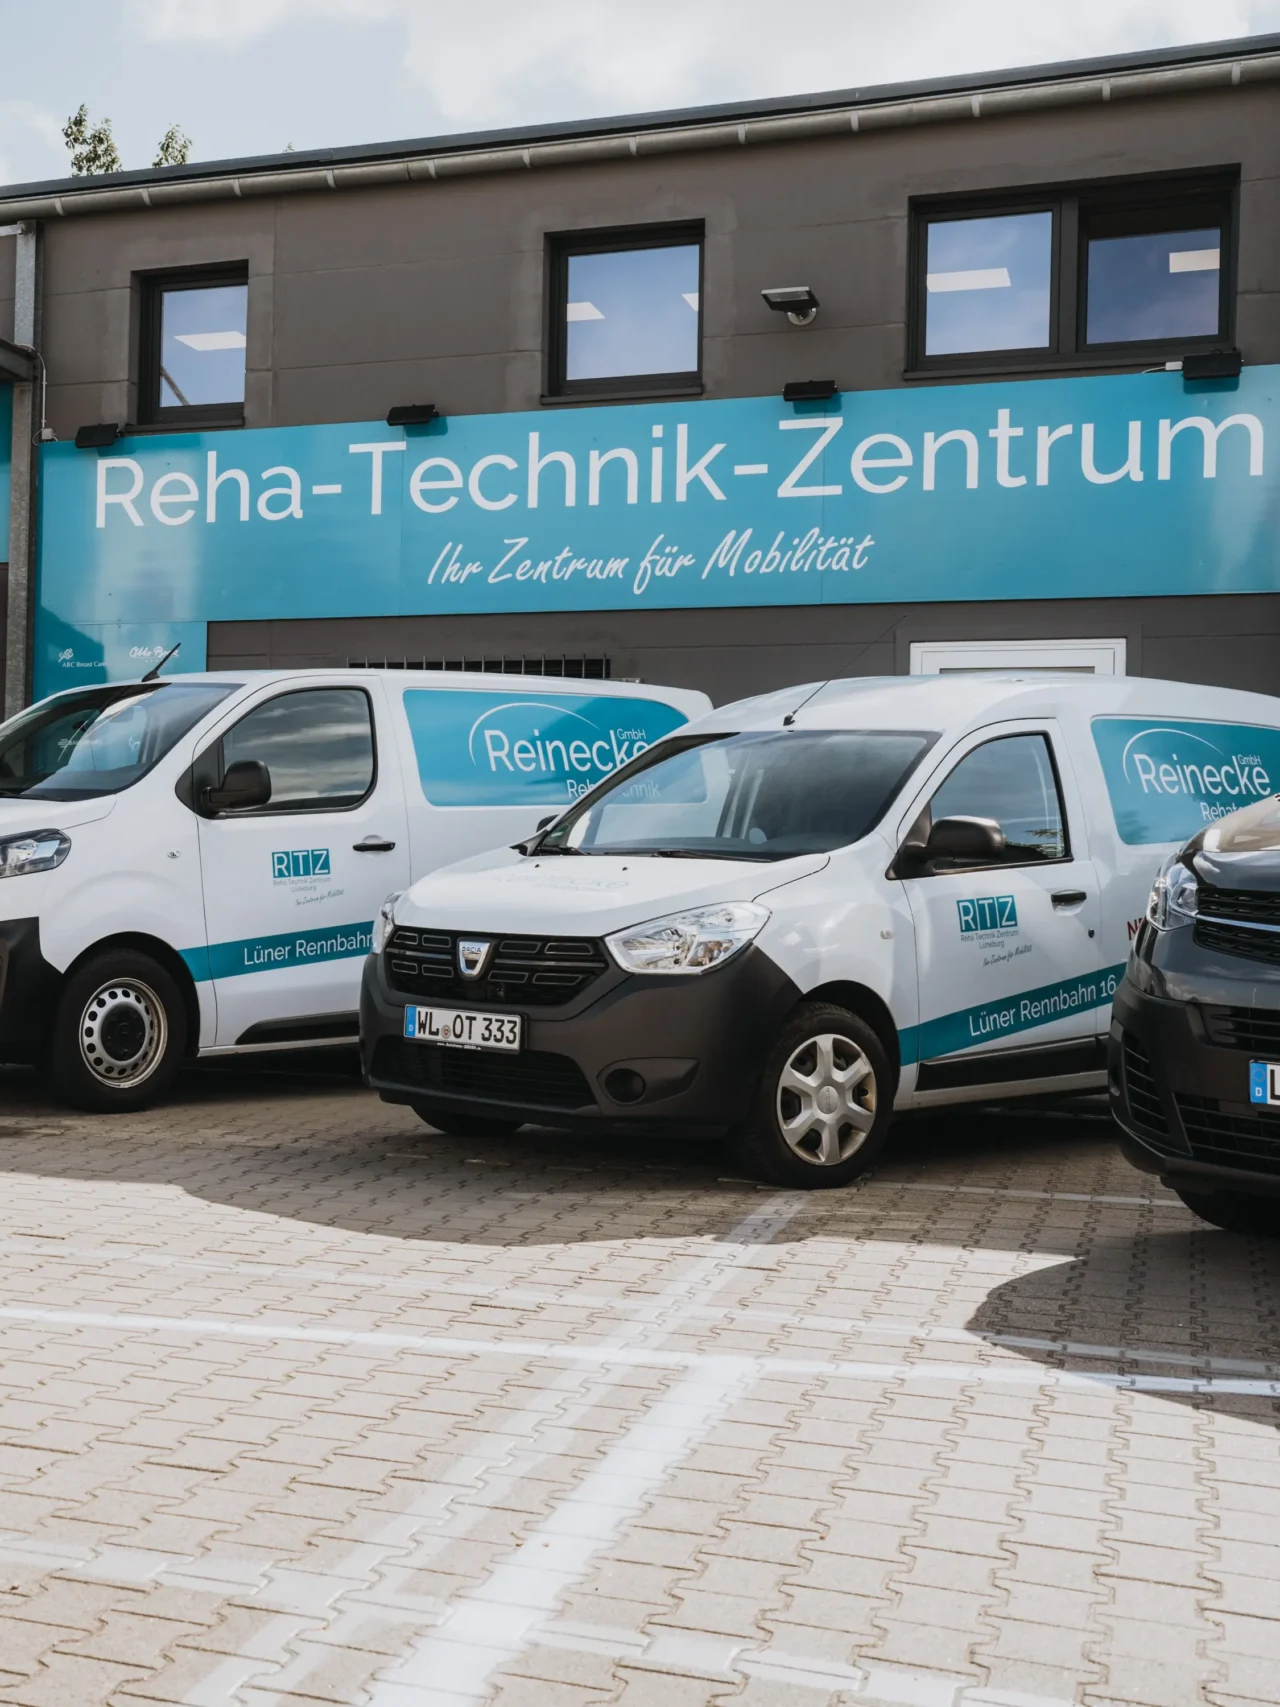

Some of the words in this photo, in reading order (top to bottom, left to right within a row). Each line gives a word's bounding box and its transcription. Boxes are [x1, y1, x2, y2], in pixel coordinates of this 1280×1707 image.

[94, 408, 1264, 529] Reha-Technik-Zentrum
[427, 541, 482, 585] Ihr
[488, 537, 627, 583] Zentrum
[633, 534, 695, 595] für
[702, 526, 875, 580] Mobilität
[484, 729, 649, 772] Reinecke
[617, 728, 646, 740] GmbH
[1133, 754, 1271, 796] Reinecke
[1237, 755, 1262, 766] GmbH
[1200, 802, 1247, 821] Rehat
[274, 851, 329, 877] RTZ
[959, 897, 1016, 931] RTZ
[244, 944, 291, 966] Lüner
[296, 931, 372, 958] Rennbahn
[961, 934, 975, 942] Reha
[979, 941, 1005, 949] Lüneburg
[970, 1009, 1016, 1036] Lüner
[1020, 983, 1096, 1021] Rennbahn
[1100, 975, 1117, 997] 16
[418, 1011, 439, 1036] WL
[453, 1014, 476, 1040] OT
[482, 1017, 517, 1044] 333
[1270, 1069, 1280, 1101] L
